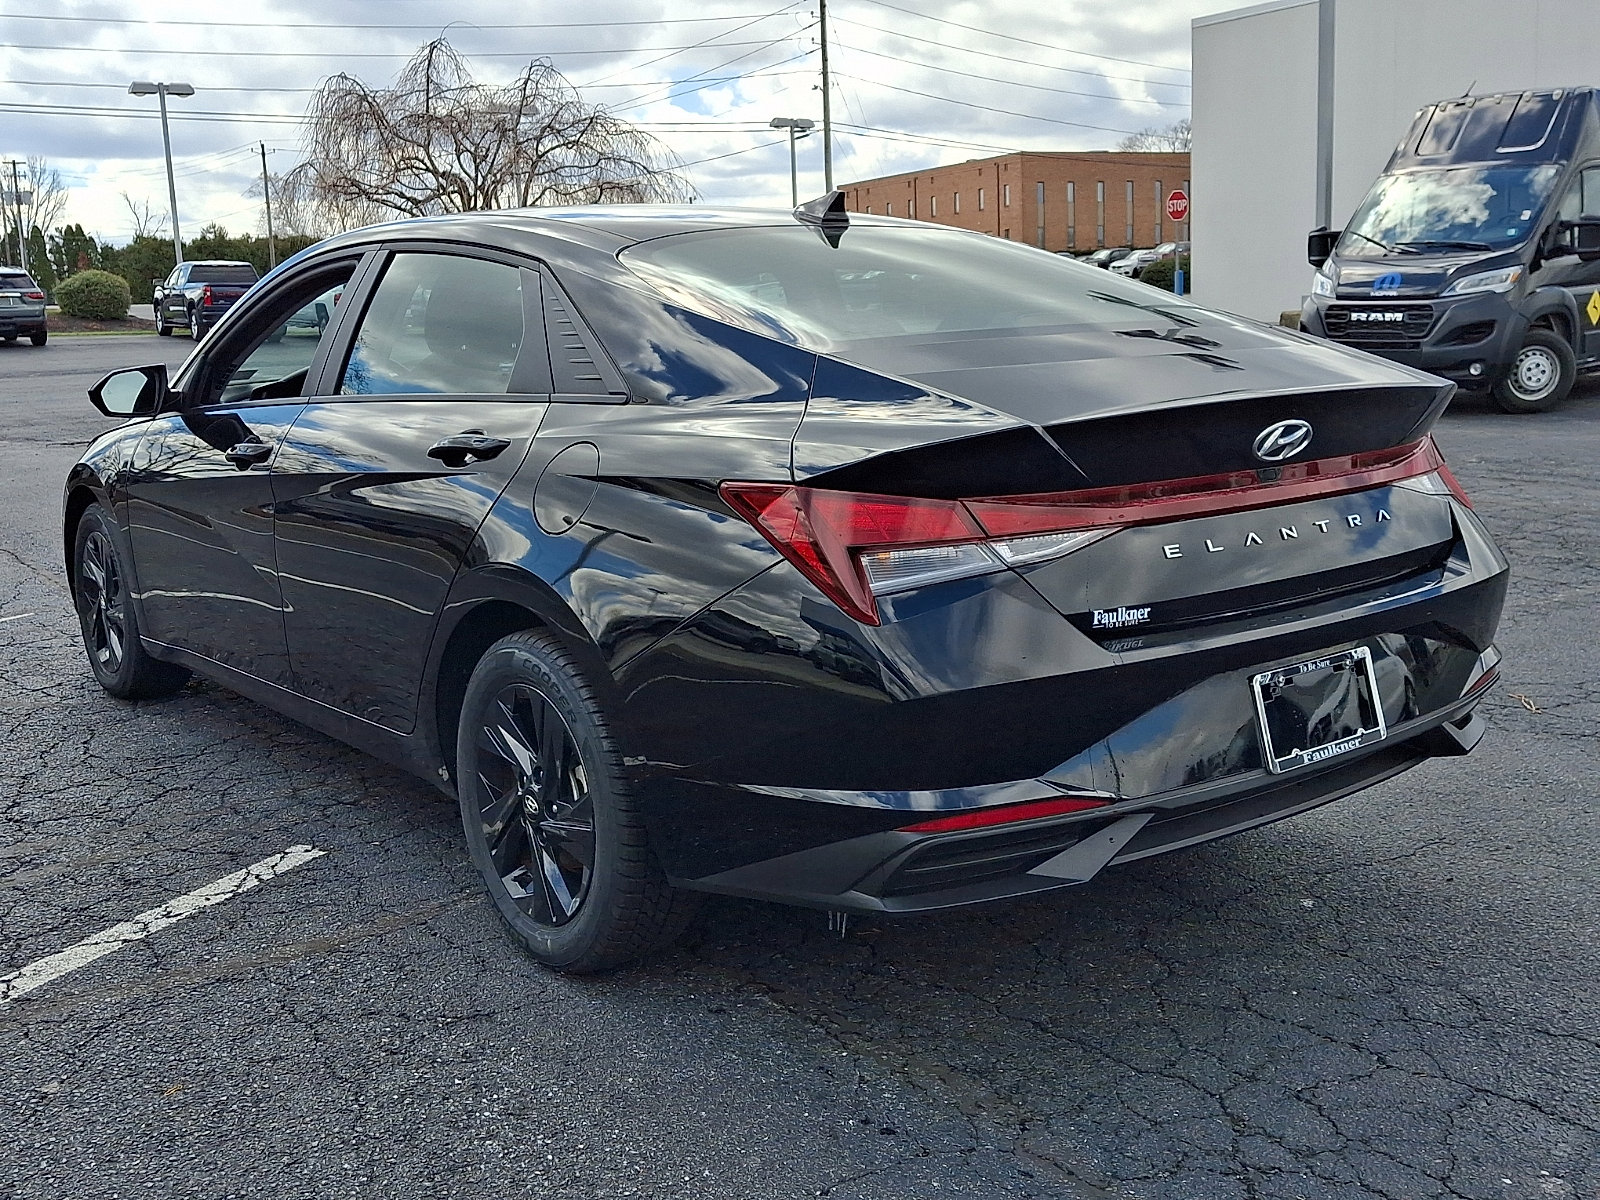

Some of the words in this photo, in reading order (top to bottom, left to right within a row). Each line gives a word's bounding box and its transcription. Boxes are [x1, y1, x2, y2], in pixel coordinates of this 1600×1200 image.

[1168, 199, 1187, 212] STOP
[1350, 312, 1404, 322] RAM
[1162, 509, 1391, 559] ELANTRA
[1092, 607, 1151, 625] Faulkner
[1299, 665, 1307, 674] To
[1308, 662, 1316, 671] Be
[1316, 659, 1331, 669] Sure
[522, 658, 577, 723] COOPER
[1302, 738, 1362, 764] Faulkner
